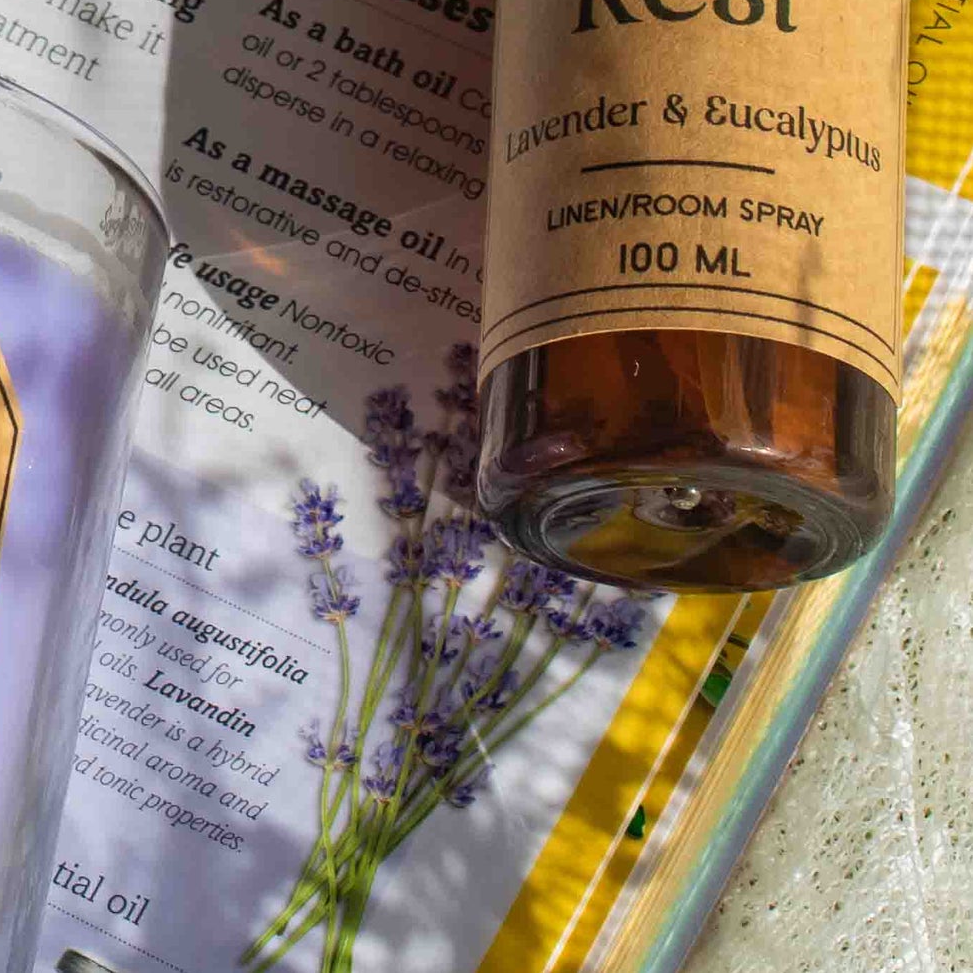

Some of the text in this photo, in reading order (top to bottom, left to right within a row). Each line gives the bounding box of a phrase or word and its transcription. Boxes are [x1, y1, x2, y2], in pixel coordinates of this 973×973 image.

[139, 23, 165, 56] it
[333, 27, 407, 77] bath
[412, 69, 458, 100] oil
[242, 33, 275, 59] oil
[305, 59, 327, 82] 2
[329, 69, 486, 156] tablespoons
[223, 66, 486, 201] disperse relaxing
[505, 96, 648, 164] Lavender
[662, 94, 688, 128] &
[705, 95, 882, 173] Eucalyptus
[182, 126, 446, 263] As massage oil
[186, 171, 384, 275] restorative and
[547, 193, 825, 237] LINEN/ROOM SPRAY
[619, 242, 751, 278] 100 ML
[162, 290, 301, 367] nonirritant.
[193, 258, 395, 366] usage Nontoxic
[178, 385, 256, 434] areas.
[192, 346, 327, 420] used neat
[136, 521, 221, 572] plant
[157, 639, 244, 691] used for
[171, 608, 310, 686] augustifolia
[143, 669, 257, 738] Lavandin
[145, 755, 269, 821] aroma and
[164, 720, 281, 787] is hybrid
[92, 766, 245, 853] tonic properties.
[107, 895, 150, 926] oil
